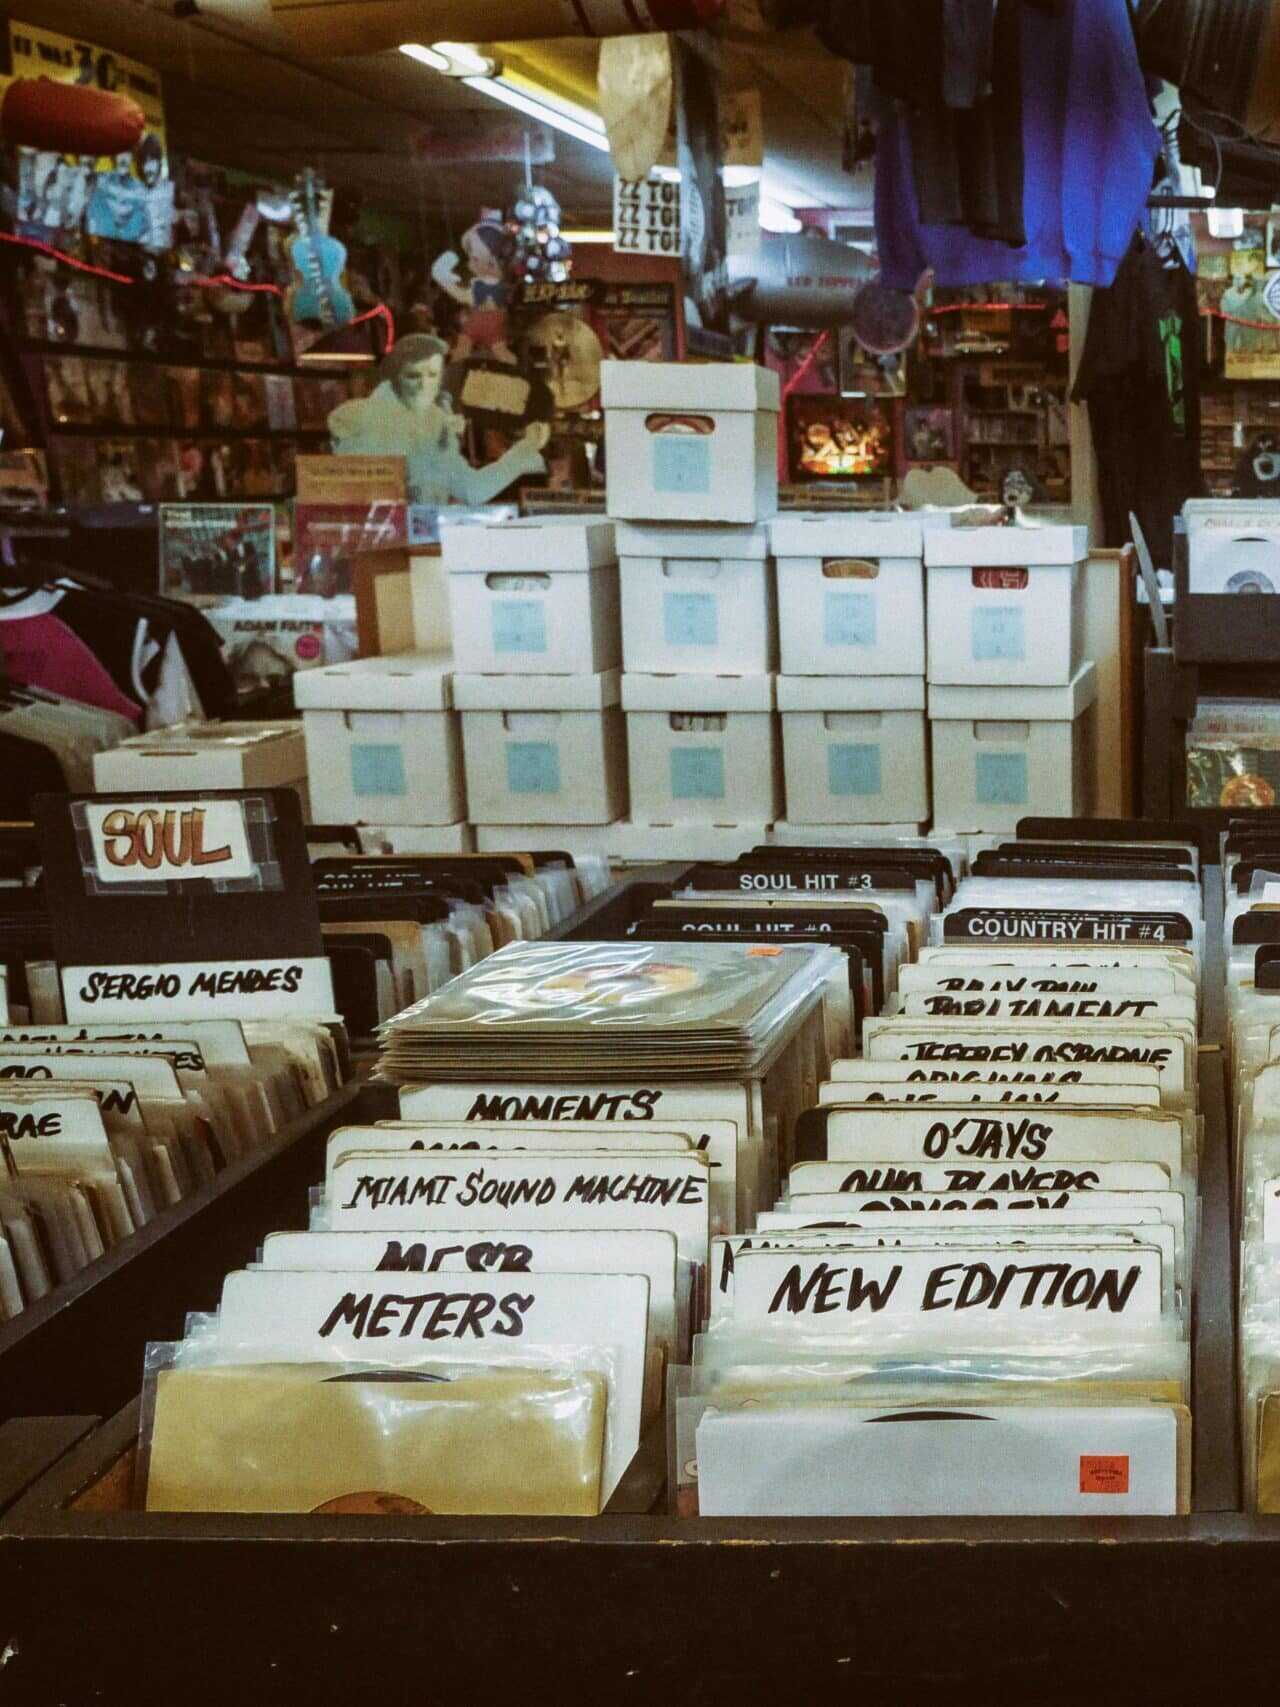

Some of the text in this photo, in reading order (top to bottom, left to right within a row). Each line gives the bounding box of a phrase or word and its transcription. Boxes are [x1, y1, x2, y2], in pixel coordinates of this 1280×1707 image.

[618, 202, 641, 225] ZZ
[618, 227, 641, 250] ZZ
[101, 806, 234, 870] SOUL
[739, 873, 873, 890] SOUL HIT #3
[968, 917, 1166, 942] COUNTRY HIT #4
[79, 965, 304, 1004] SERGIO MENDES
[464, 1088, 663, 1121] MOMENTS
[922, 1117, 1054, 1161] O'JAYS
[341, 1167, 708, 1210] MIAMI SOUND MACHINE
[767, 1261, 1143, 1315] NEW EDITION
[317, 1291, 536, 1341] METERS
